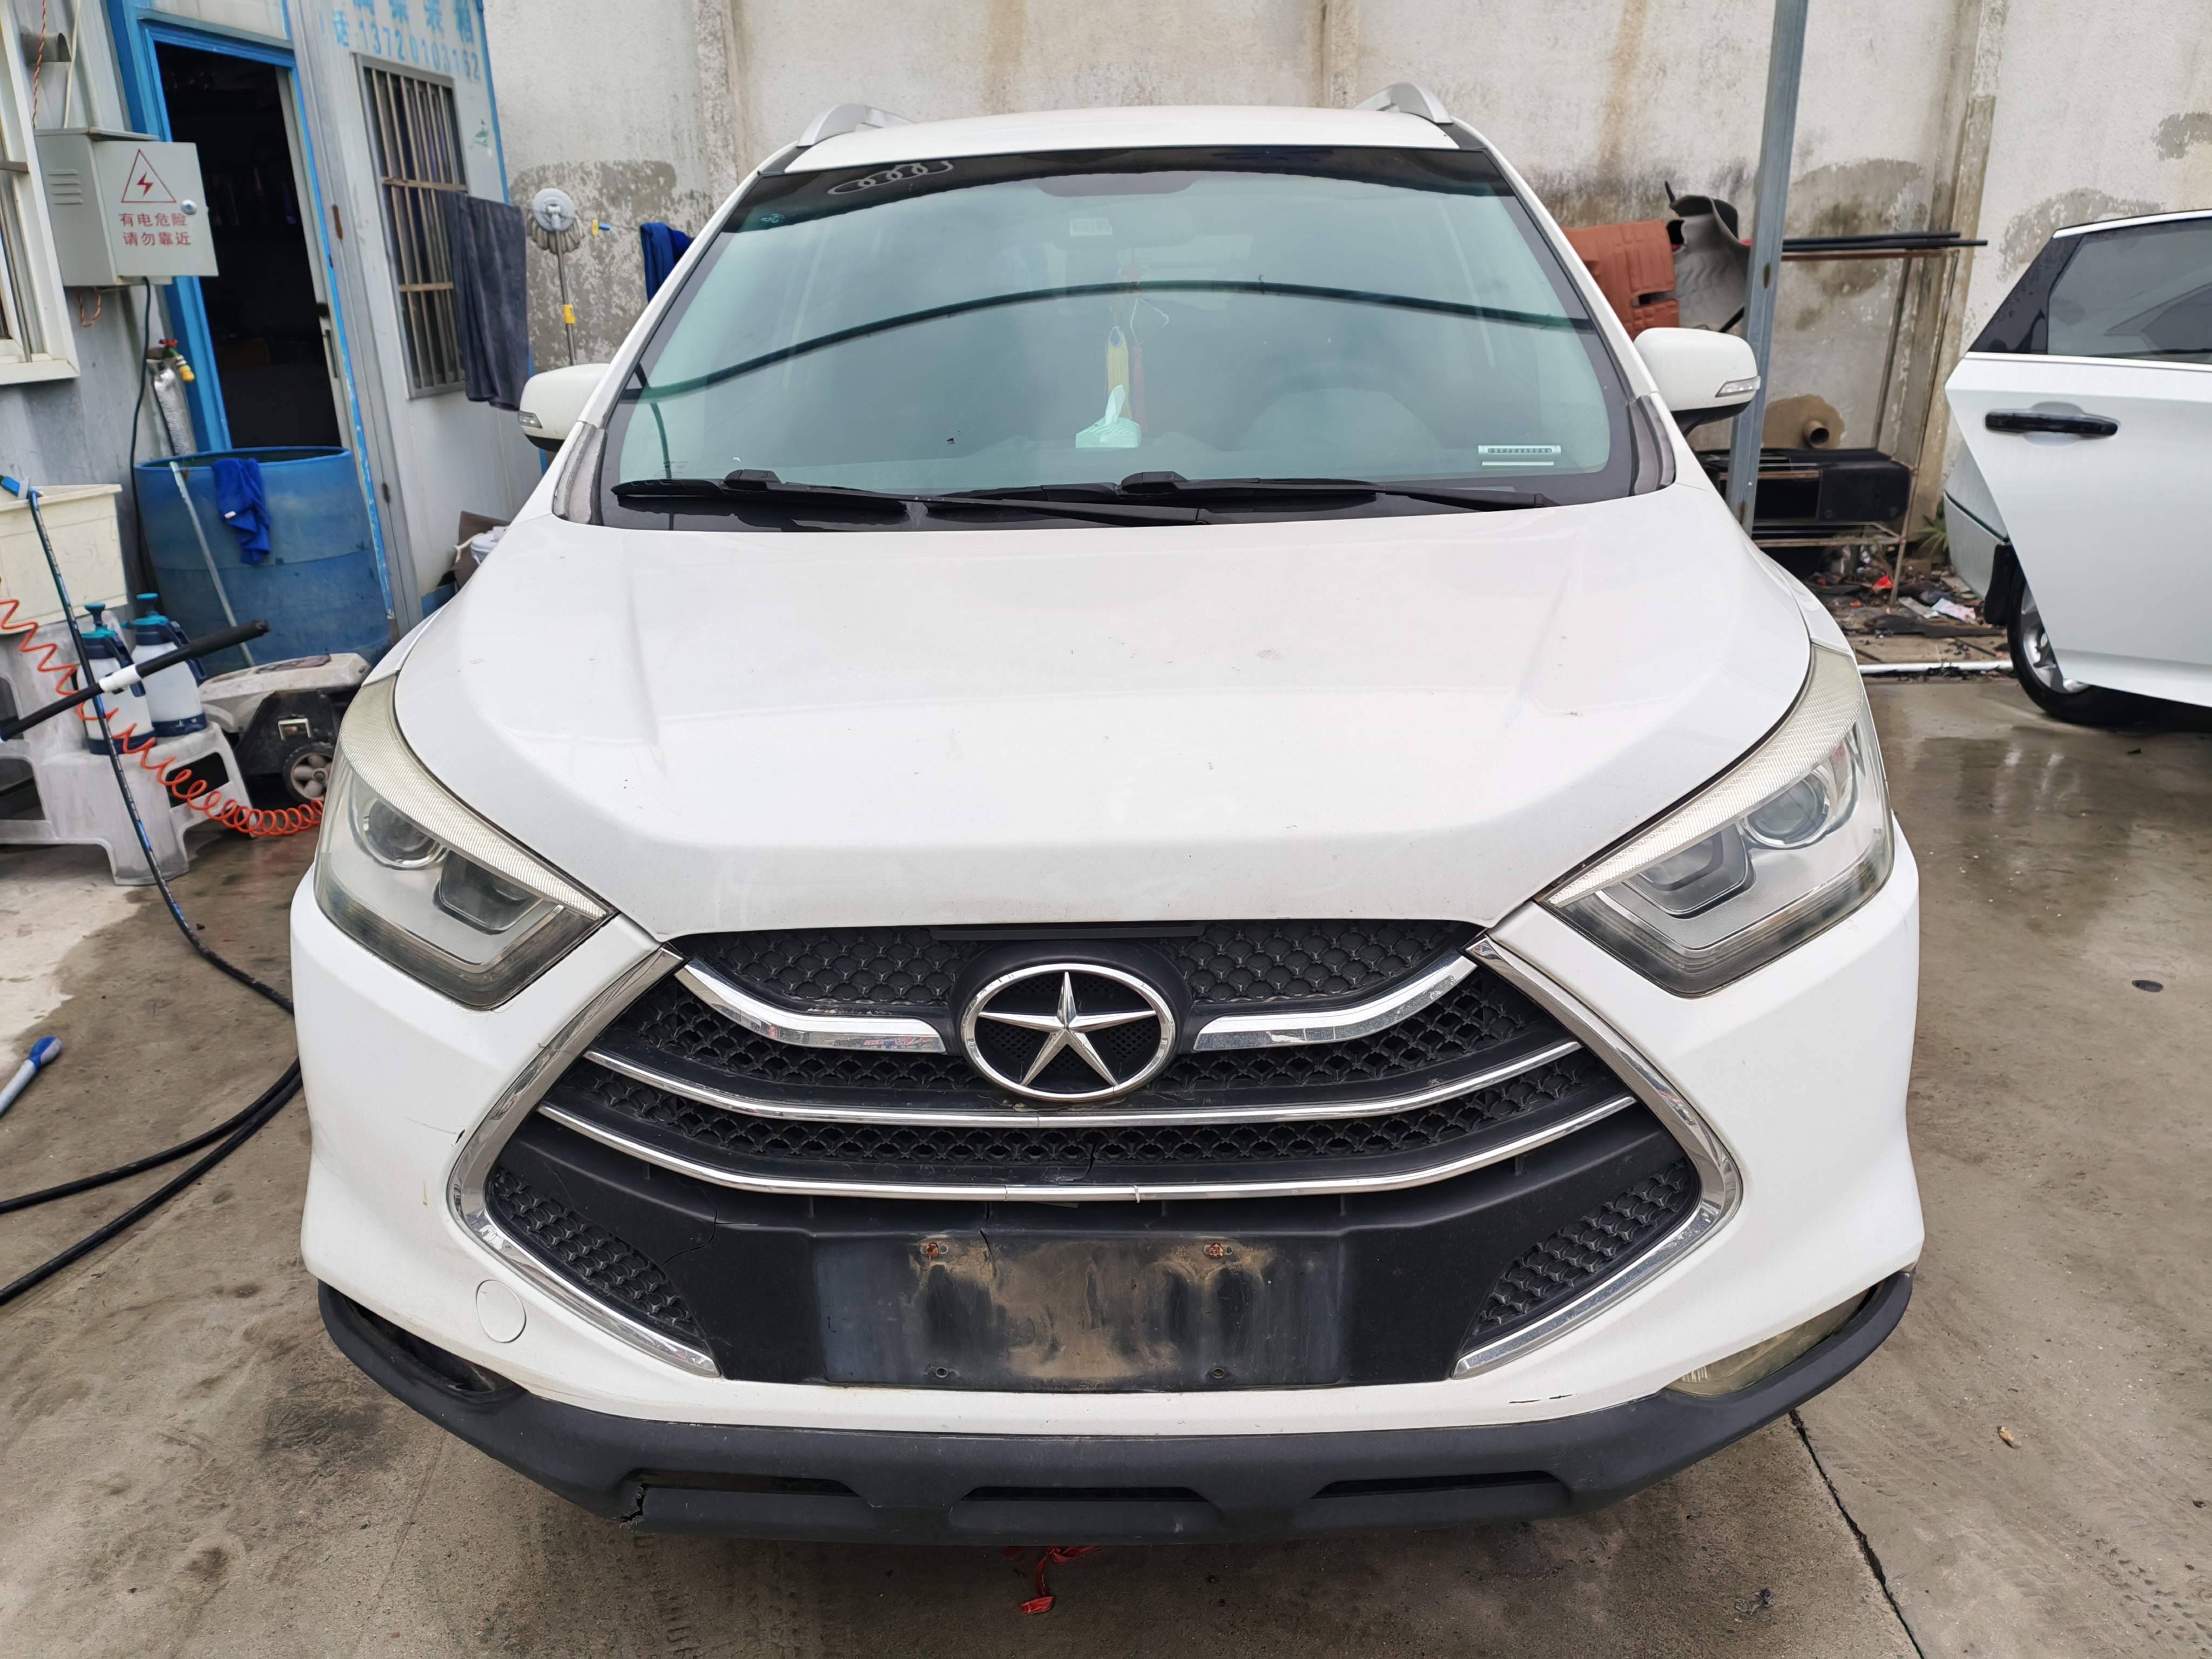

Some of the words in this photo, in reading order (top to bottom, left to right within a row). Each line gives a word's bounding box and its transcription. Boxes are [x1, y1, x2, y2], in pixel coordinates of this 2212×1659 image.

[119, 212, 187, 227] 有电危险
[123, 232, 191, 246] 请勿靠近
